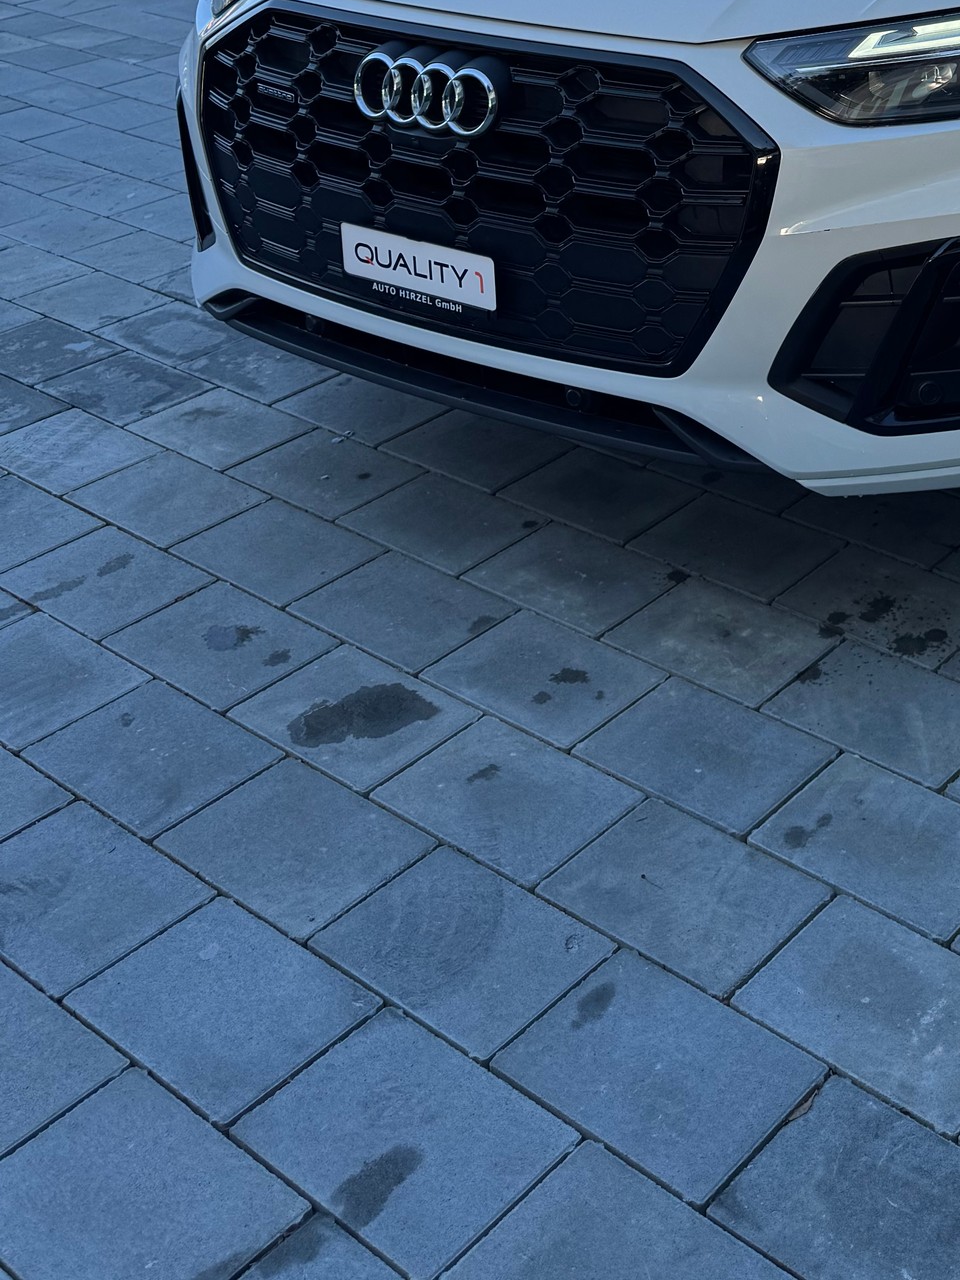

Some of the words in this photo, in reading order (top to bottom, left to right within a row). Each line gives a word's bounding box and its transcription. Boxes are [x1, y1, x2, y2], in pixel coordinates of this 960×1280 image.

[372, 282, 397, 296] AUTO
[399, 289, 433, 305] HIRZEL
[435, 299, 463, 313] GmbH
